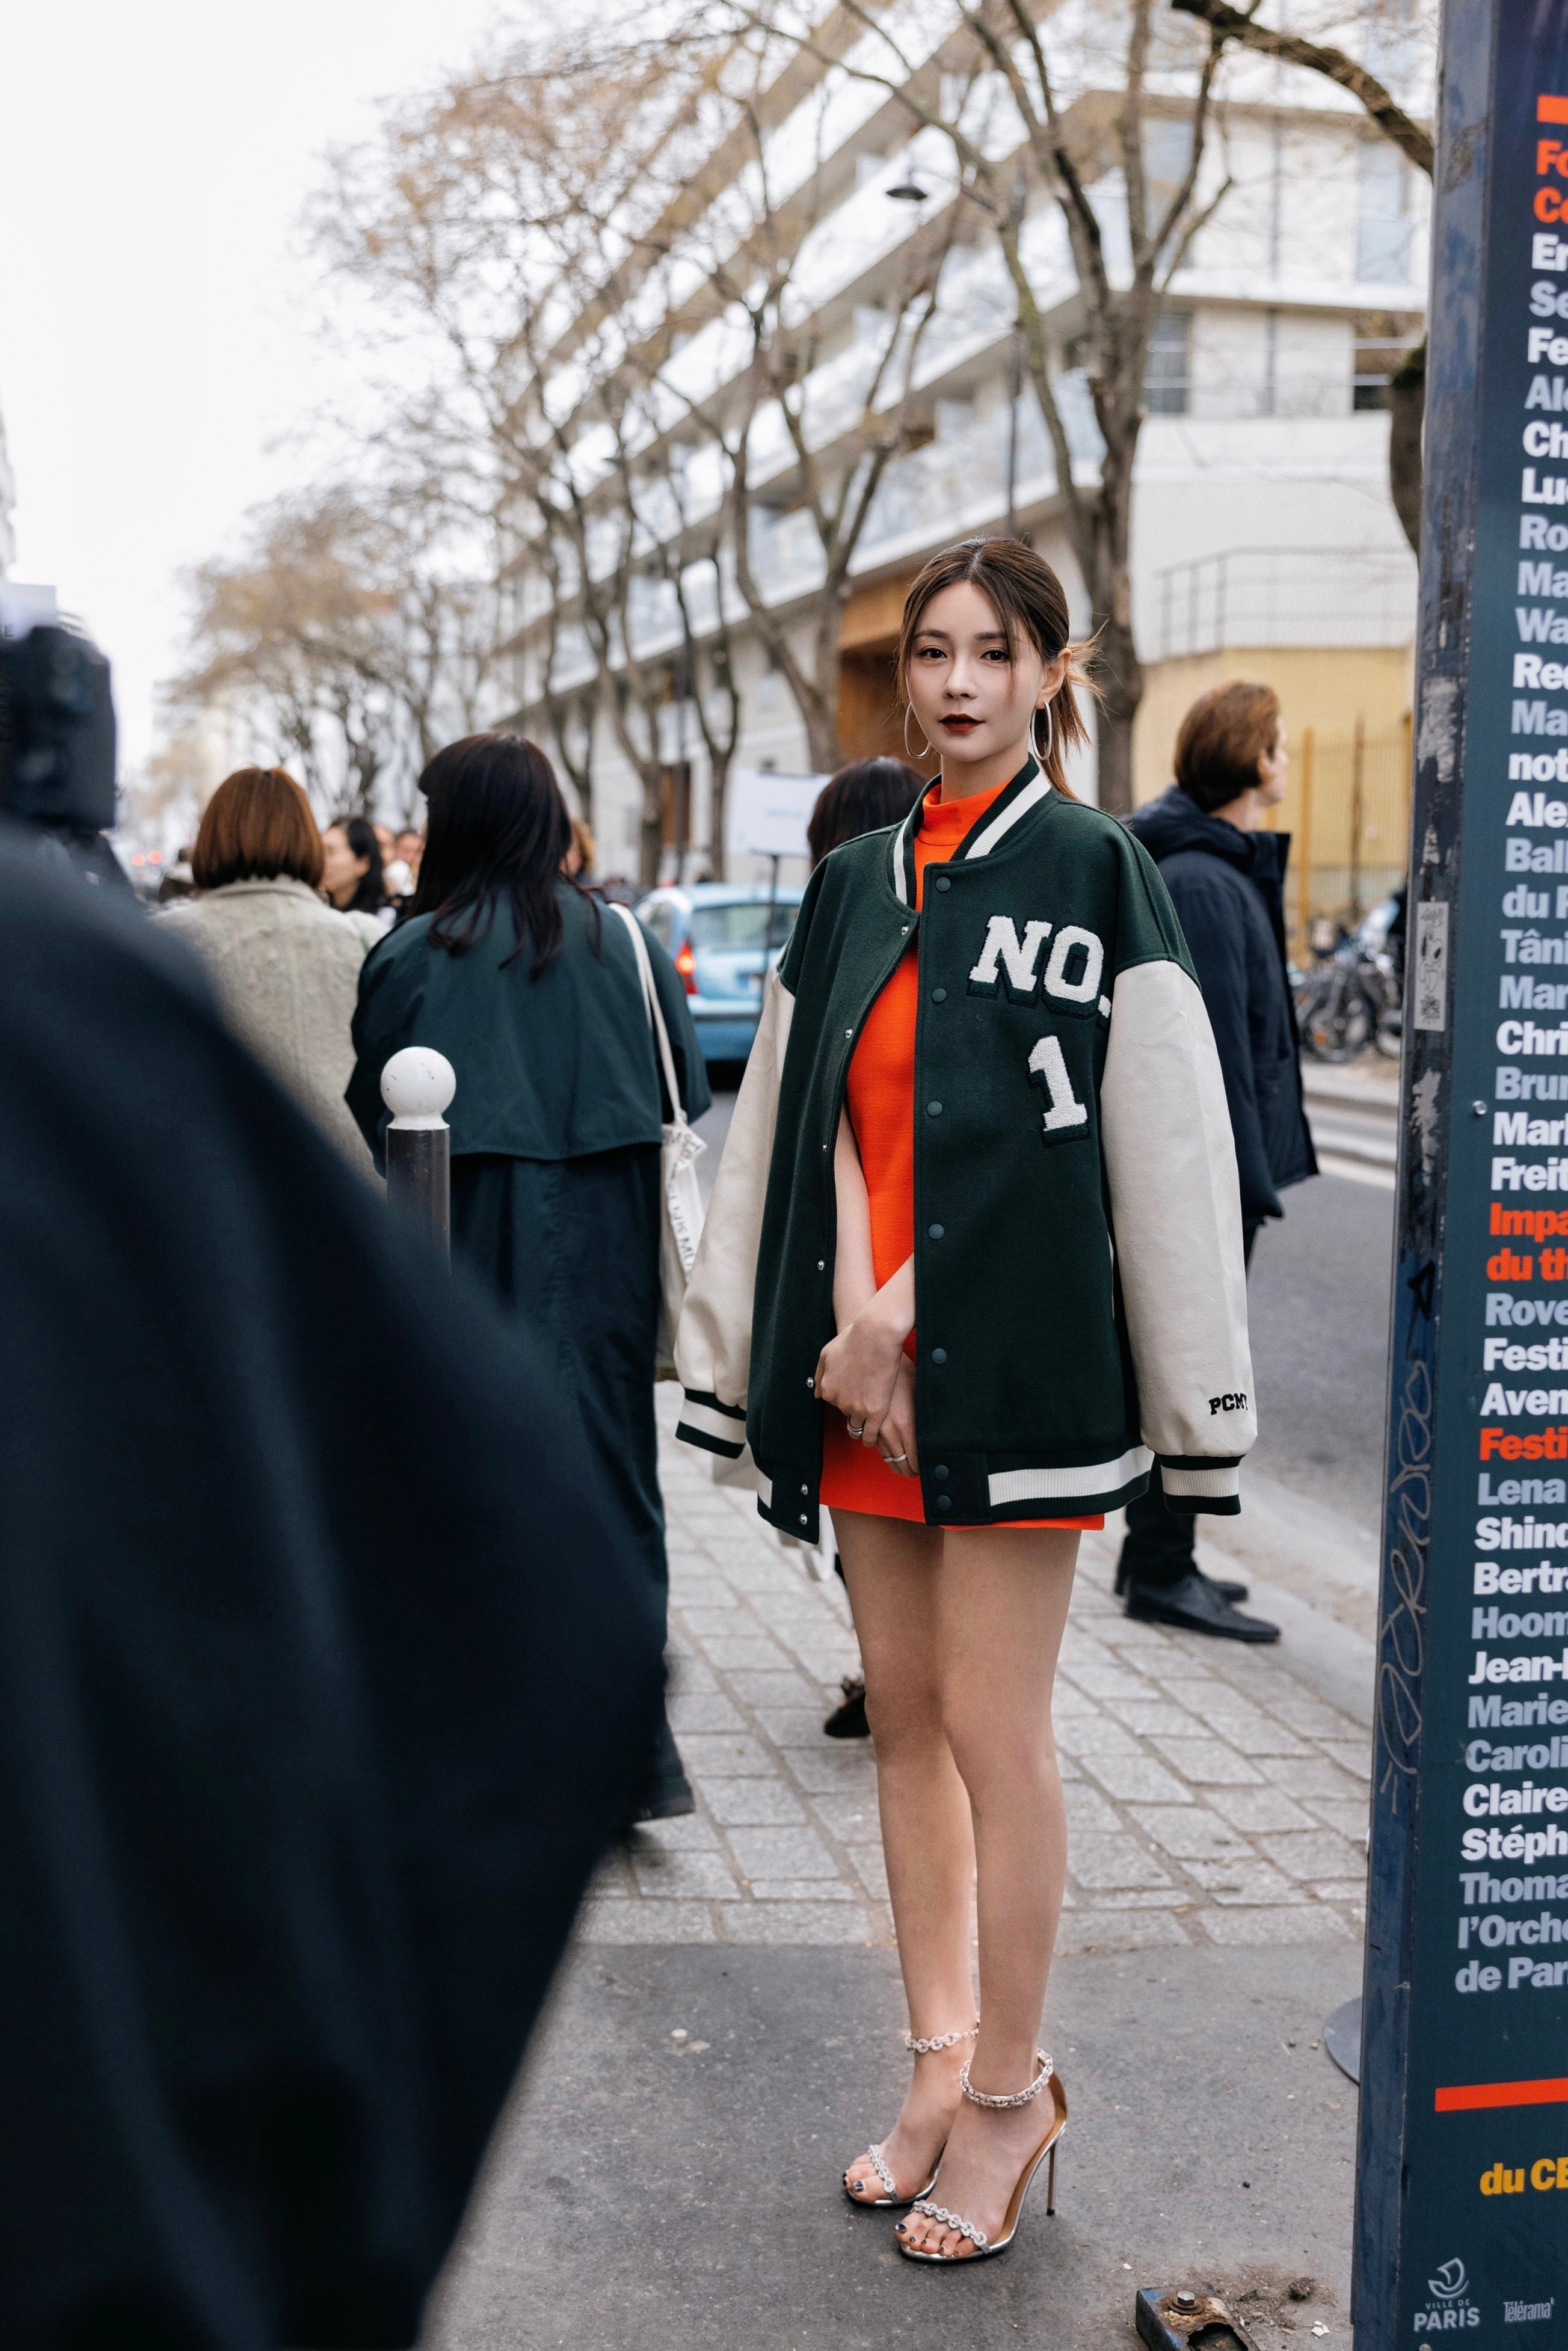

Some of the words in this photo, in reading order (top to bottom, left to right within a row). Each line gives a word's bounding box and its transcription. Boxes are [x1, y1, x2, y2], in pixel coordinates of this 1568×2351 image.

[1523, 374, 1568, 412] Al
[1521, 466, 1568, 506] Lu
[1518, 512, 1568, 552] Ro
[1517, 558, 1568, 598] Ma
[1514, 606, 1568, 645] Wa
[1512, 651, 1568, 691] Re
[1510, 698, 1568, 737] Ma
[1508, 748, 1568, 783] not
[1505, 790, 1568, 829] Ale
[1501, 883, 1550, 920] du
[1027, 1034, 1089, 1138] 1
[1493, 1111, 1568, 1146] Mar
[1486, 1247, 1533, 1281] du
[1480, 1426, 1568, 1461] Festi
[1477, 1472, 1566, 1505] Lena
[1473, 1560, 1568, 1595] Bertr
[1468, 1647, 1568, 1685] Jean-
[1468, 1692, 1568, 1729] Marie
[1463, 1780, 1568, 1818] Claire
[1460, 1824, 1568, 1864] Stéph
[1455, 1959, 1502, 1993] de
[1480, 2162, 1525, 2196] du
[1413, 2306, 1481, 2332] PARIS
[1425, 2300, 1453, 2310] VILLE
[1458, 2299, 1471, 2307] DE
